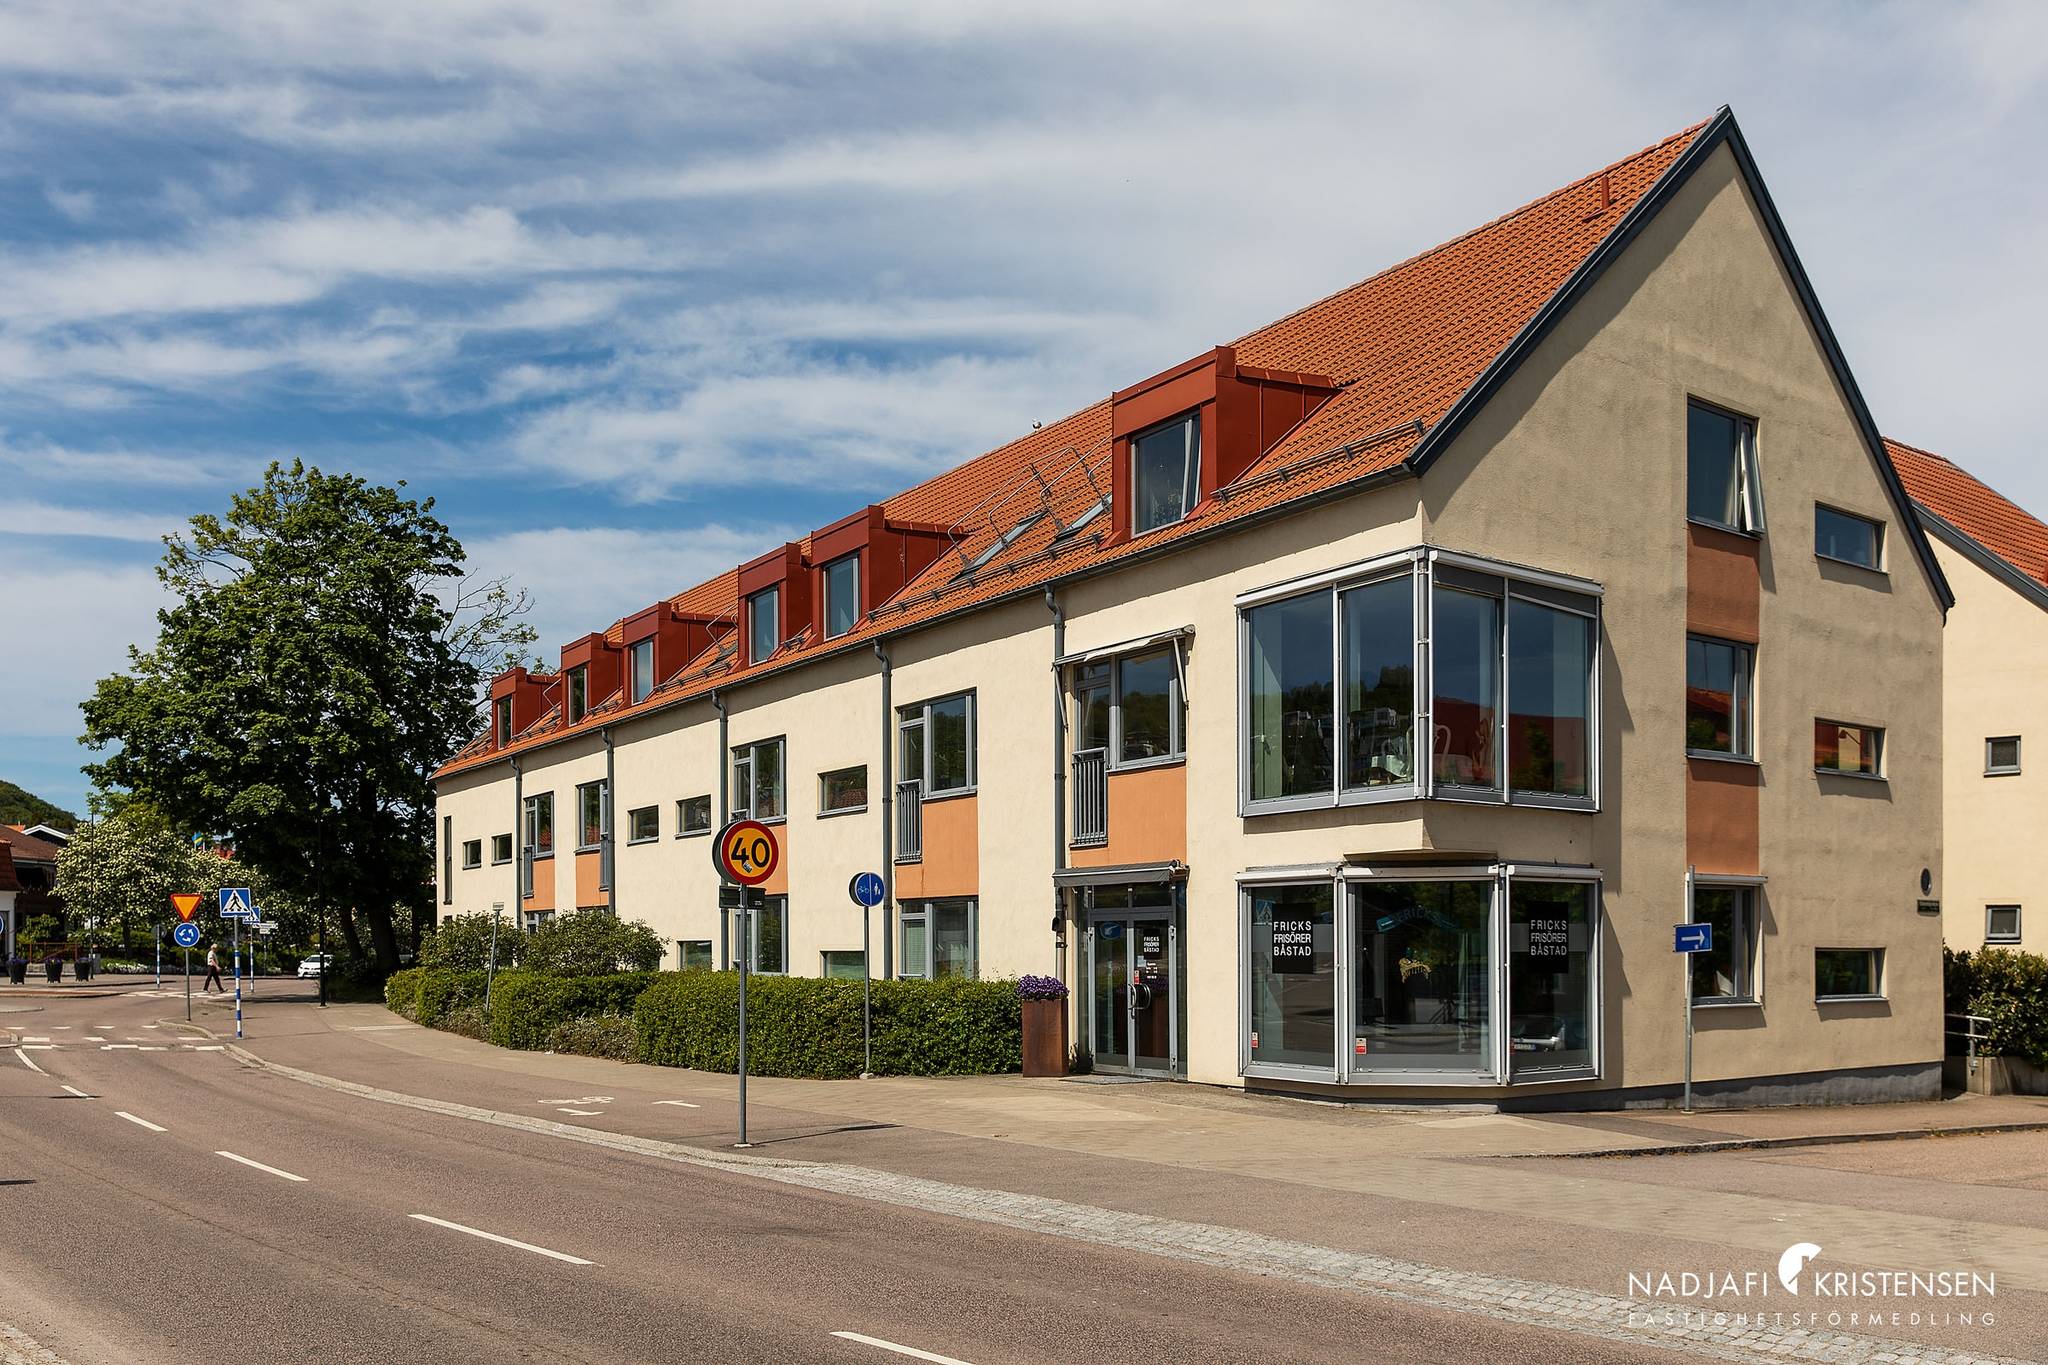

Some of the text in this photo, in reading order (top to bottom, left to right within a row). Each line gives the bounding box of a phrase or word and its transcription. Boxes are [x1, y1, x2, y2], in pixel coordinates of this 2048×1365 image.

[731, 837, 770, 868] 40
[1273, 920, 1312, 931] FRICKS
[1530, 920, 1567, 930] FRICKS
[1273, 931, 1312, 943] FRISÖRER
[1530, 930, 1567, 943] FRISÖRER
[1273, 943, 1312, 956] BÅSTAD
[1530, 942, 1567, 956] BÅSTAD
